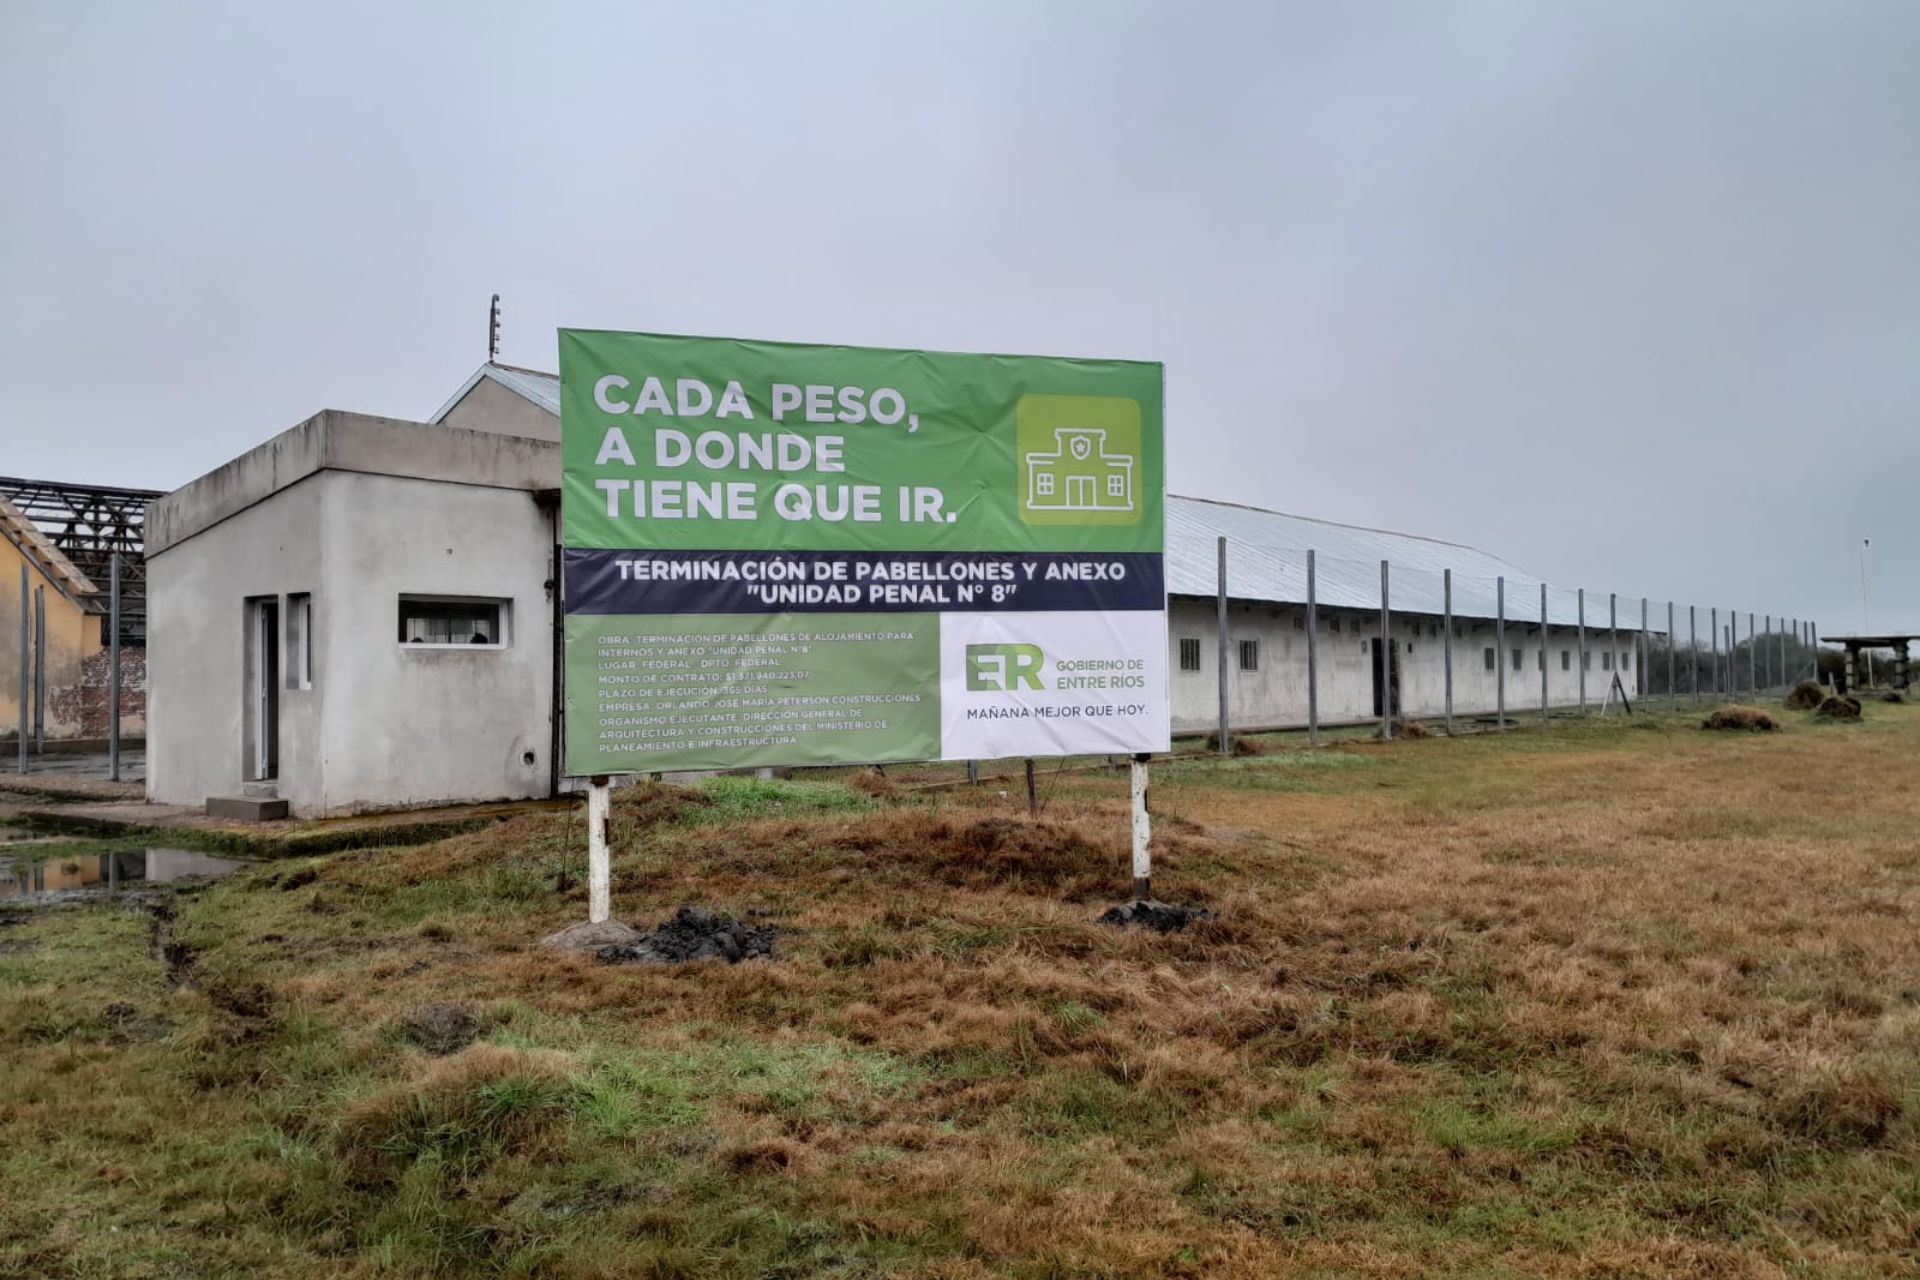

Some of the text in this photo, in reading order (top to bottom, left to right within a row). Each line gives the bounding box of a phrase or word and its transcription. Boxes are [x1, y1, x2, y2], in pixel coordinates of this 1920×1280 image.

[593, 374, 919, 433] CADA PESO,
[594, 427, 846, 472] A DONDE
[594, 479, 957, 522] TIENE QUE IR.
[615, 556, 1126, 581] TERMINACIÓN DE PABELLONES Y ANEXO
[747, 584, 1017, 604] "UNIDAD PENAL N° 8"
[713, 634, 728, 643] DE
[799, 633, 811, 641] DE
[815, 631, 884, 641] ALOJAMIENTO
[887, 631, 914, 640] PARA
[598, 648, 654, 658] INTERNOS
[656, 647, 665, 656] Y
[668, 646, 705, 656] ANEXO
[755, 645, 787, 655] PENAL
[966, 643, 1046, 691] ER
[1056, 659, 1144, 672] GOBIERNO DE
[598, 674, 640, 684] MONTO
[642, 674, 658, 683] DE
[1056, 672, 1145, 690] ENTRE RÍOS
[598, 688, 636, 699] PLAZO
[639, 688, 655, 697] DE
[656, 699, 710, 710] ORLANDO
[778, 696, 829, 706] PETERSON
[832, 693, 921, 705] CONSTRUCCIONES
[599, 716, 666, 727] ORGANISMO
[801, 709, 847, 719] GENERAL
[850, 708, 863, 717] DE
[967, 703, 1149, 720] MAÑANA MEJOR QUE HOY.
[599, 719, 888, 739] ARQUITECTURA Y CONSTRUCCIONES DEL MINISTERIO DE
[599, 736, 797, 752] PLANEAMIENTO E INFRAESTRUCTURA
